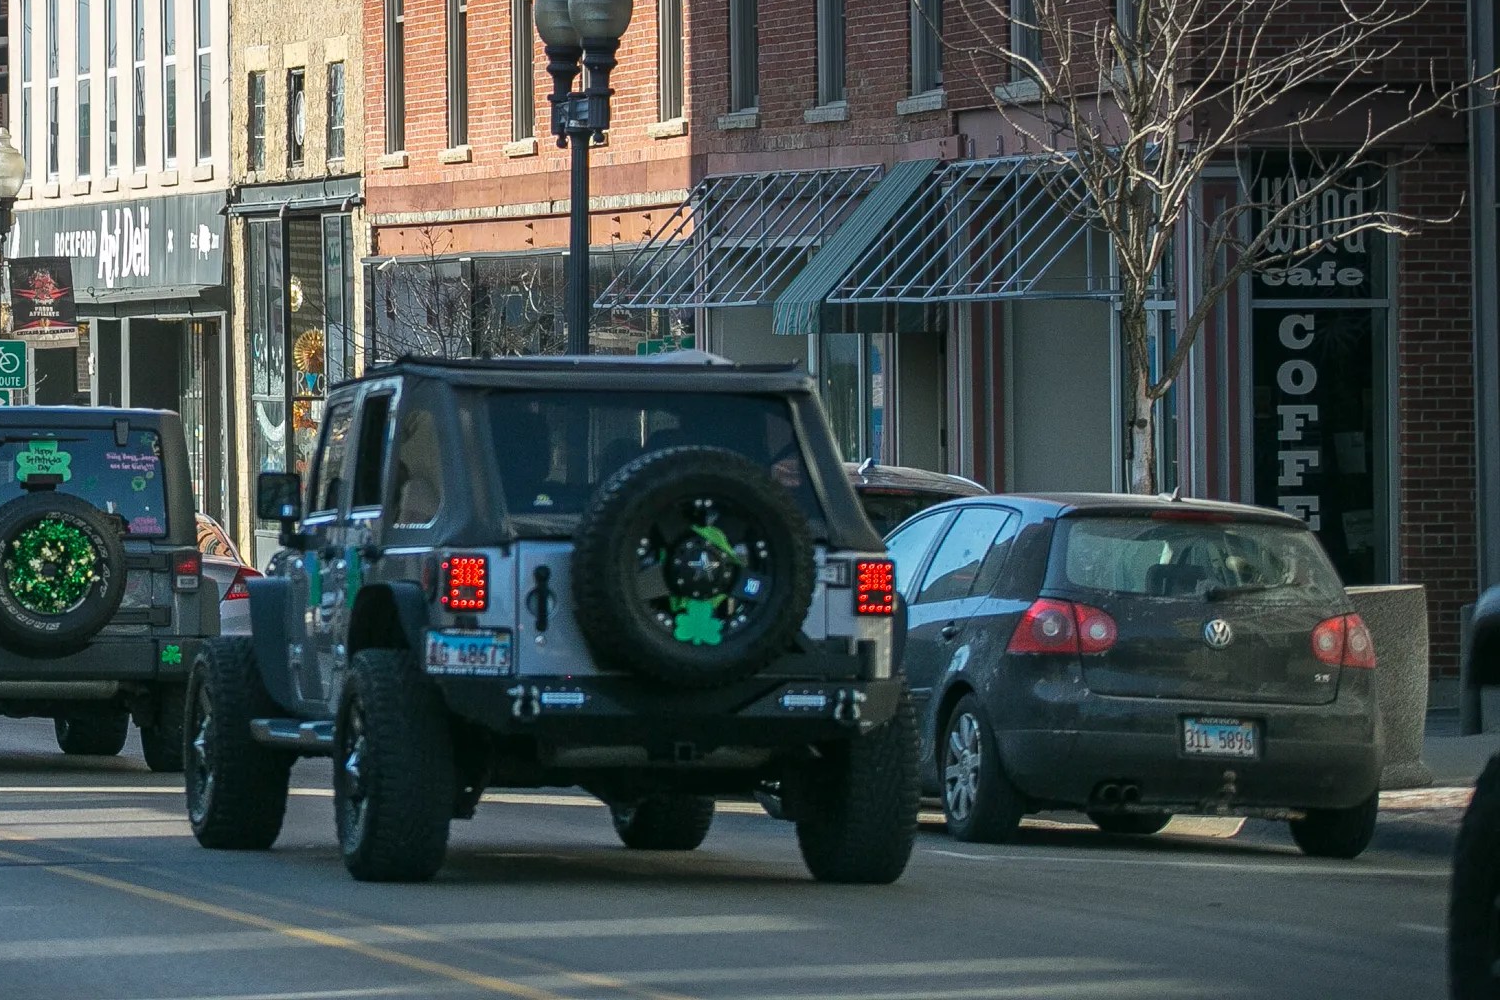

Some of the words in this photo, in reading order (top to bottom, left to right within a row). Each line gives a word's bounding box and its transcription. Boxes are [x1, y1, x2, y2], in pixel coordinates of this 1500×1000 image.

[54, 230, 98, 258] ROCKFORD
[121, 206, 150, 278] Deli
[1261, 261, 1365, 286] cafe
[1276, 314, 1320, 532] COFFE
[1185, 729, 1211, 749] 311
[1218, 730, 1253, 750] 5896
